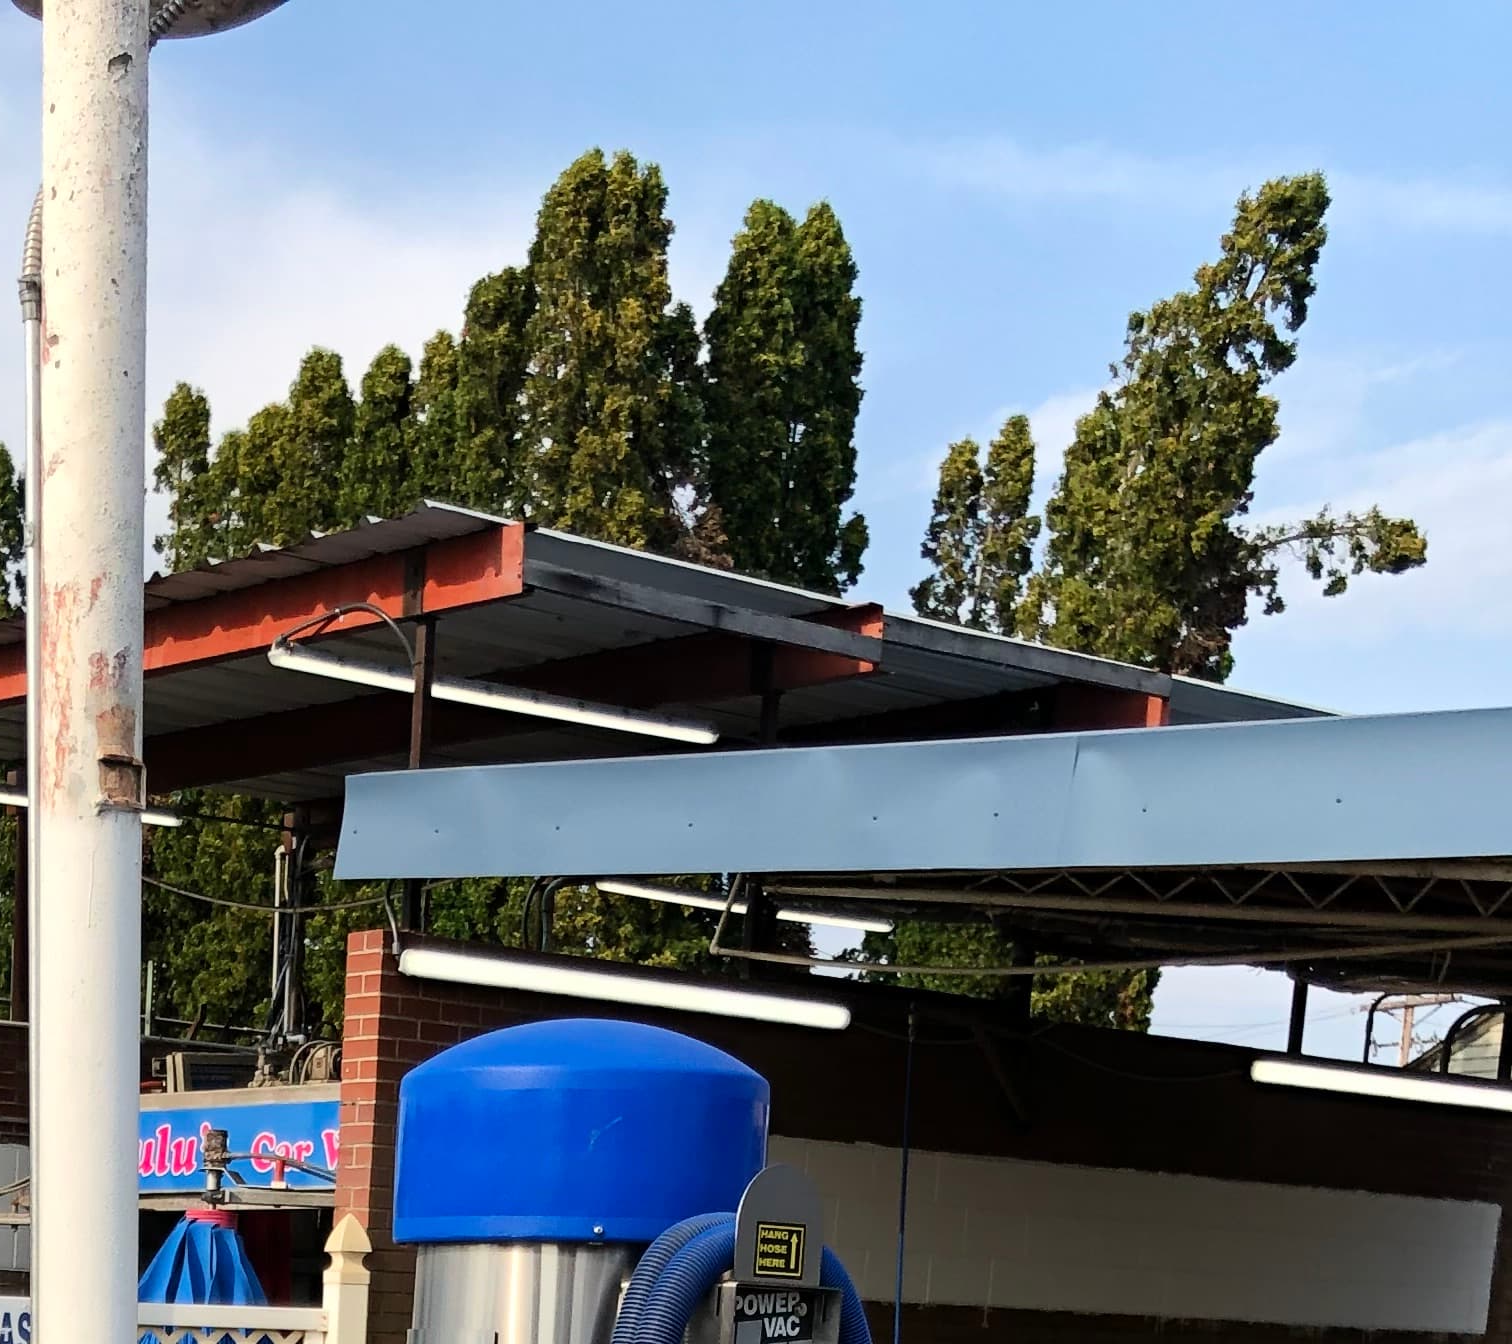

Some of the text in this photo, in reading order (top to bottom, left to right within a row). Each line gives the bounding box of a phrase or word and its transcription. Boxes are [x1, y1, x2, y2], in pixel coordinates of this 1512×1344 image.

[760, 1229, 789, 1240] HANG
[759, 1244, 787, 1255] HOSE
[758, 1257, 786, 1269] HERE
[762, 1314, 801, 1338] VAC
